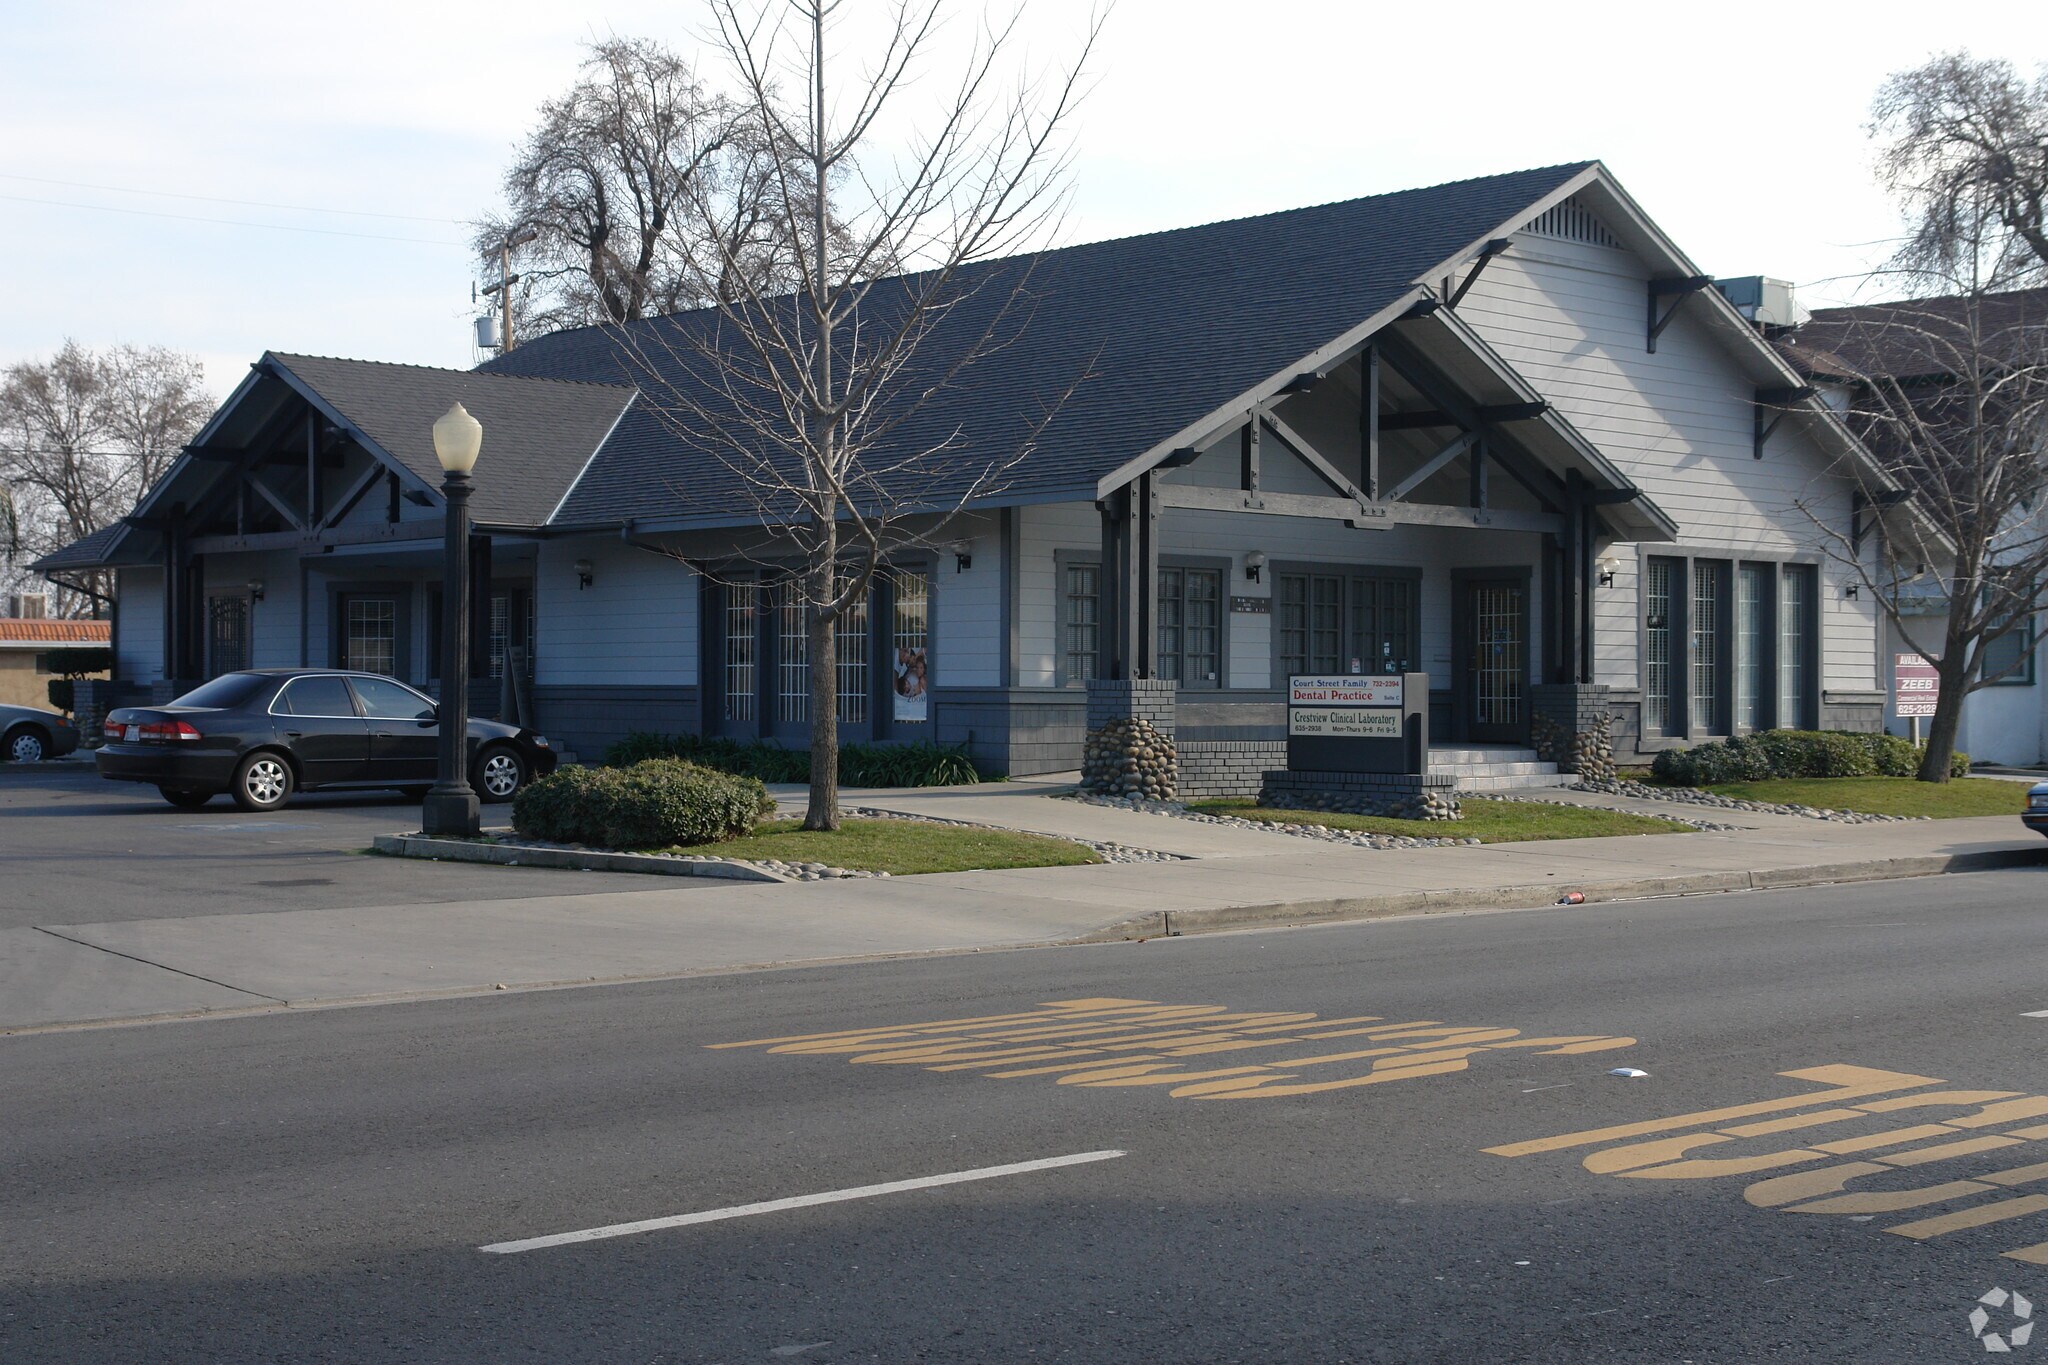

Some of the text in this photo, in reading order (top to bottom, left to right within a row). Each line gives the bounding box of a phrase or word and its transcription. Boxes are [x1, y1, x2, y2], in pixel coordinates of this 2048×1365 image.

[1900, 655, 1931, 665] AVAILAB
[1293, 679, 1368, 688] Court Street Family
[1901, 680, 1933, 689] ZEEB
[1293, 690, 1373, 700] Dental Practice
[1898, 704, 1937, 714] 625-2128
[1294, 711, 1396, 725] Crestview Clinical Laboratory
[701, 997, 1637, 1099] SCHOOL
